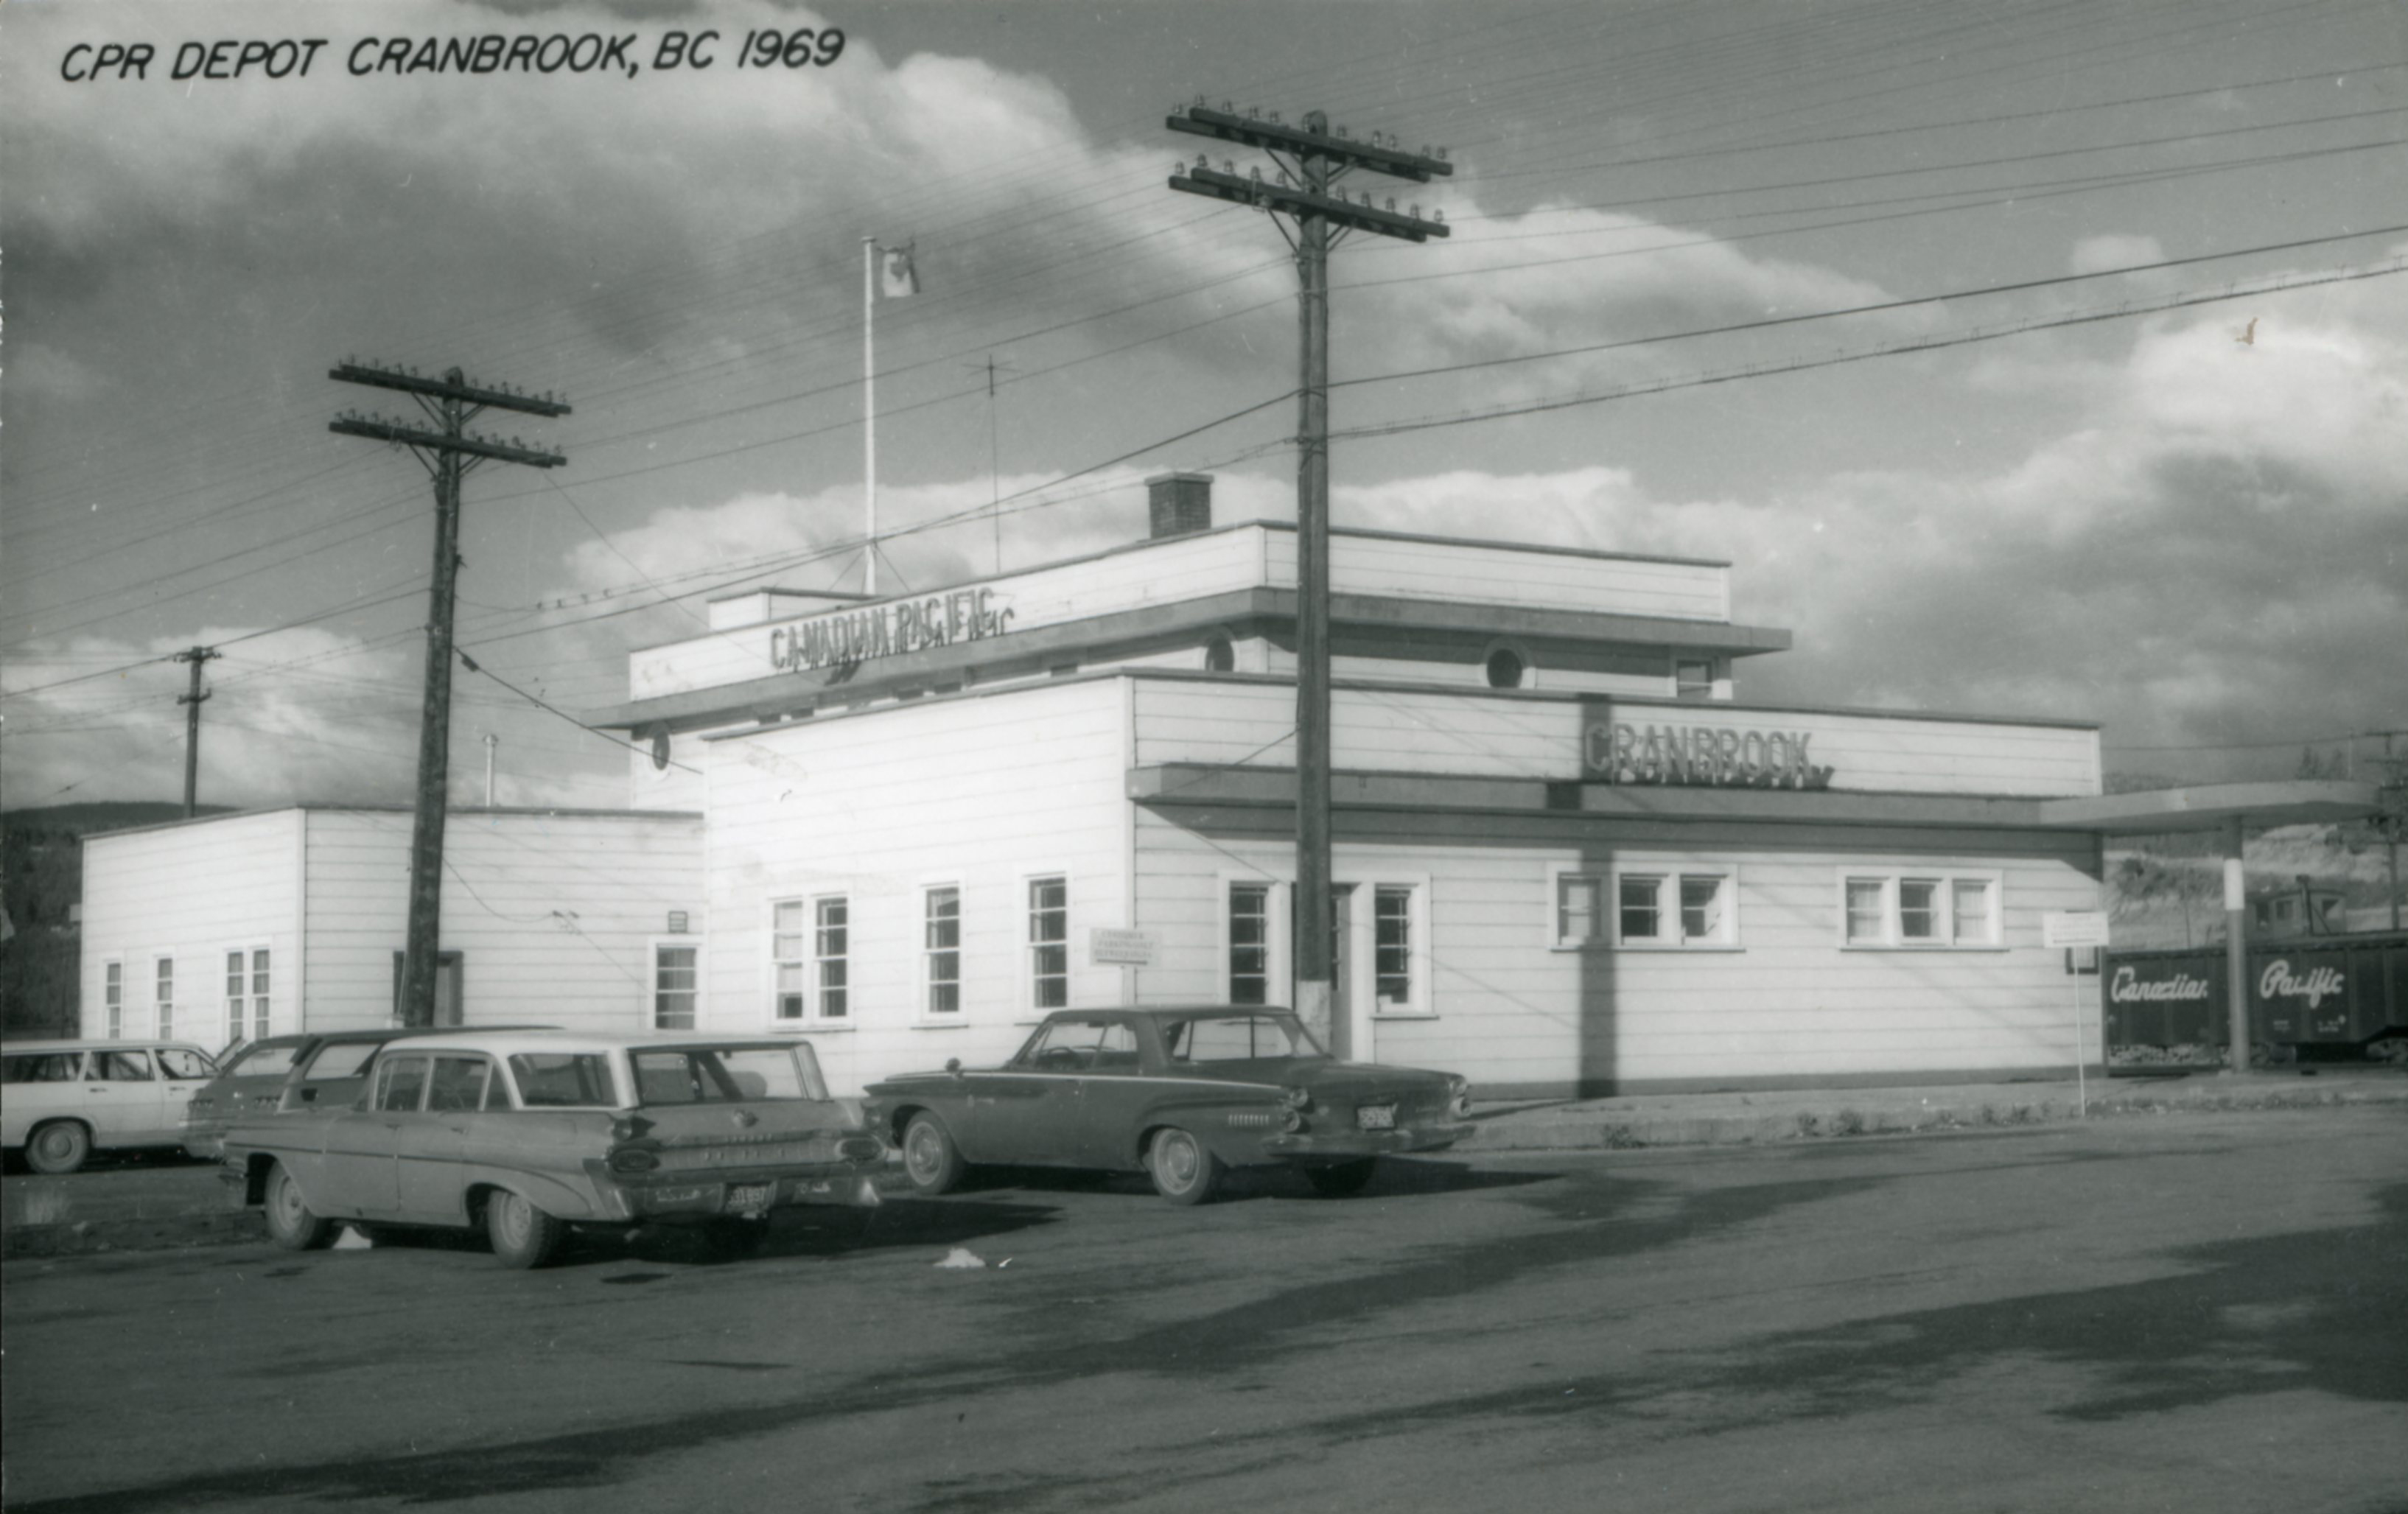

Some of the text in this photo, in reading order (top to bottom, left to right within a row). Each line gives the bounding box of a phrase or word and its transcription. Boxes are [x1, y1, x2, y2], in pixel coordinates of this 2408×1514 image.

[771, 586, 995, 667] CANADIAN PACIFIC
[1586, 722, 1813, 782] CRANBROOK
[2111, 959, 2345, 1009] Canadian Pacific
